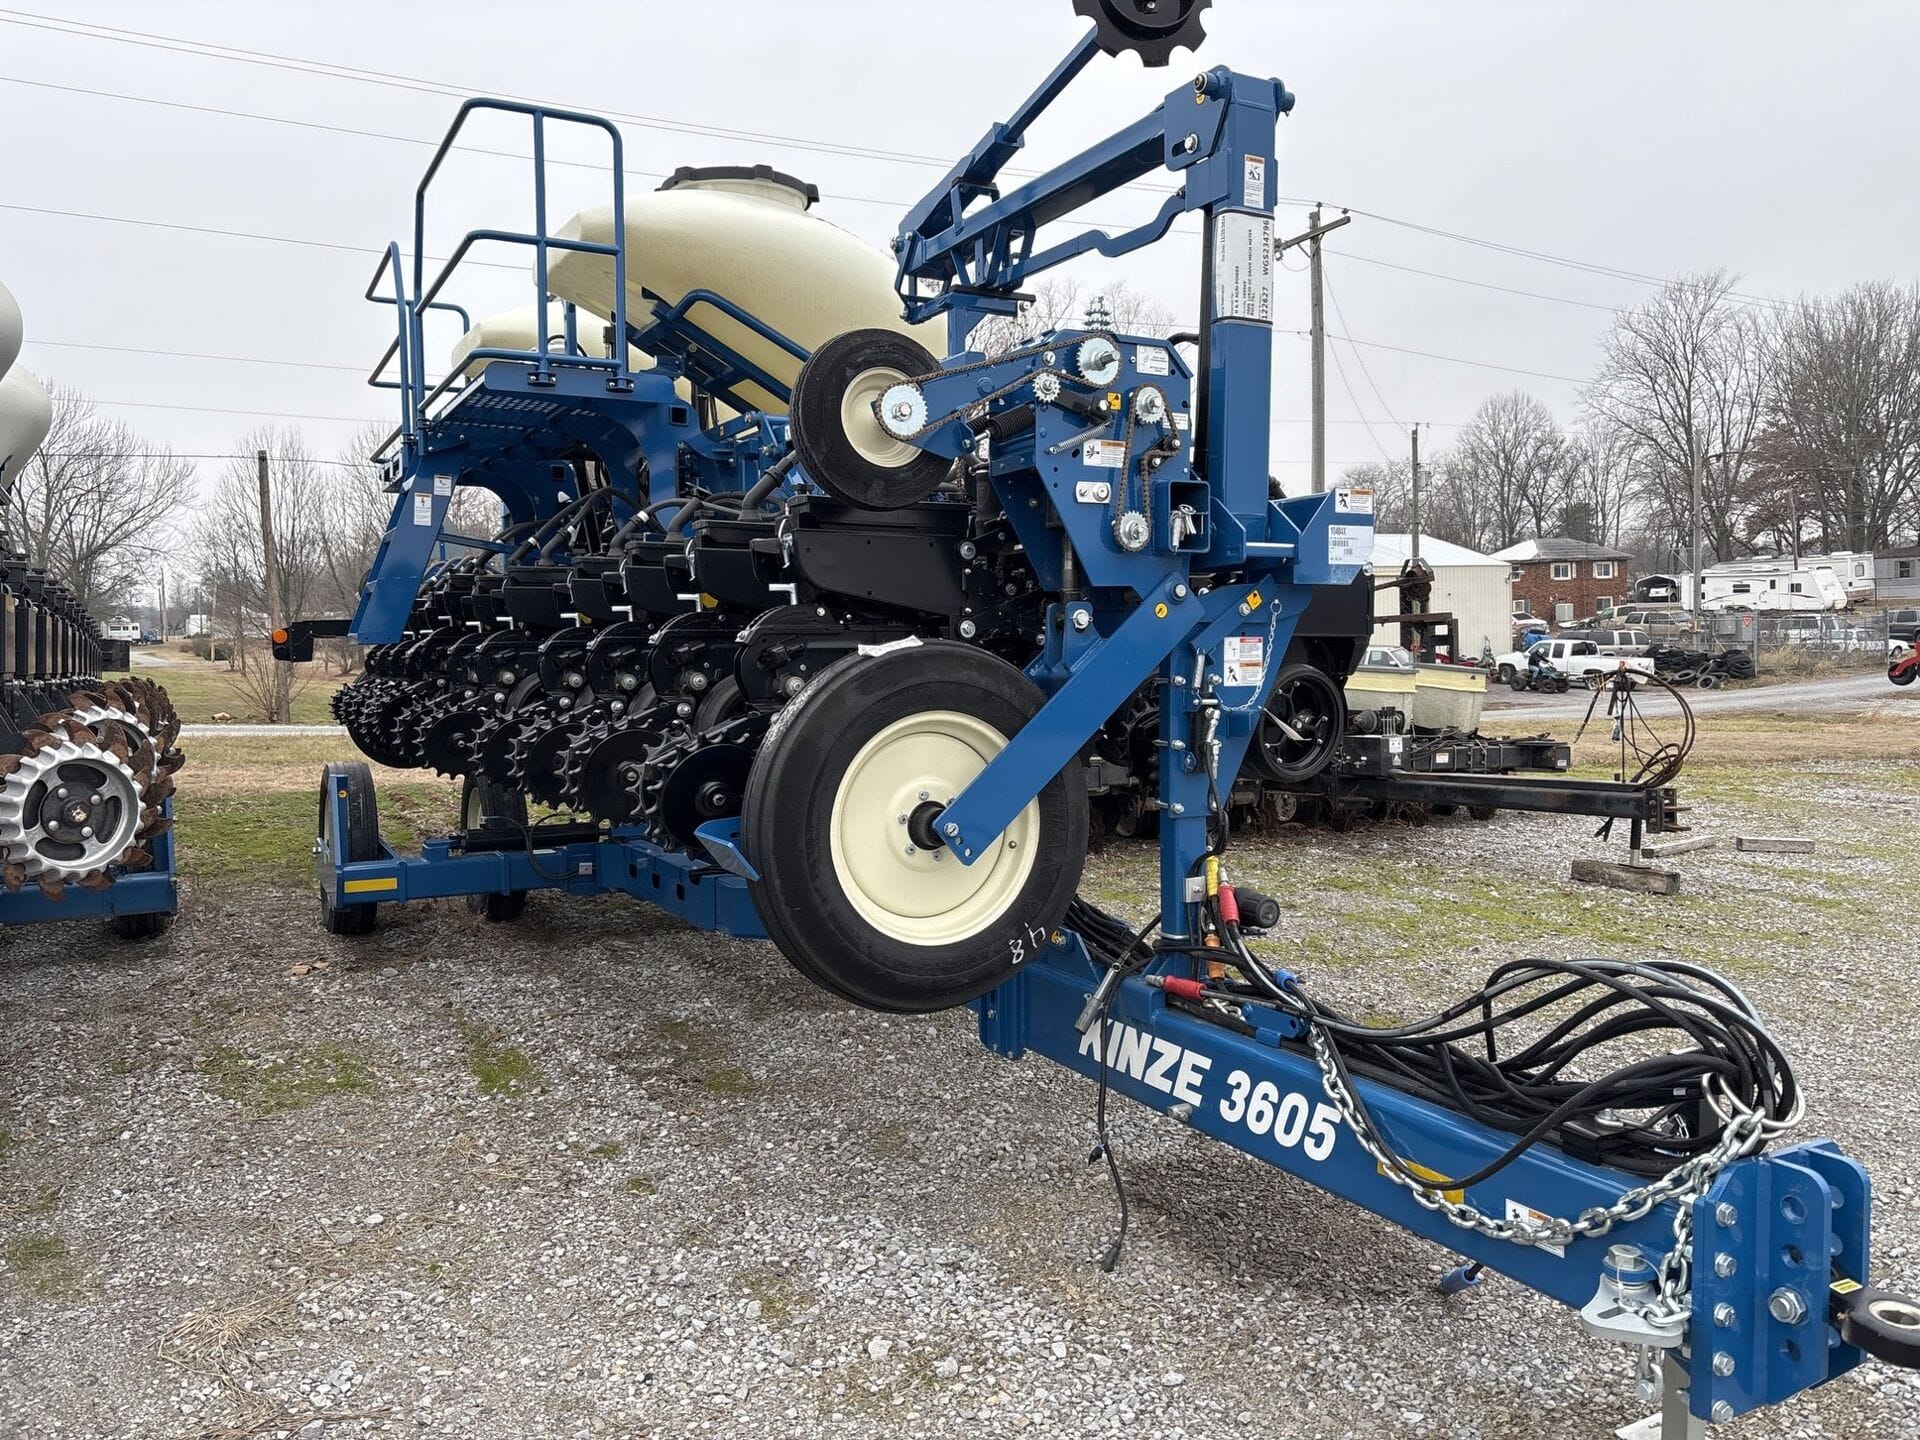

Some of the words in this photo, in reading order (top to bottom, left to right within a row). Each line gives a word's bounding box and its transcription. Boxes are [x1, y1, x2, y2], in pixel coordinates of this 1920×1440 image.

[1261, 286, 1269, 319] 122627
[1078, 1018, 1213, 1107] KINZE
[1219, 1069, 1343, 1162] 3605
